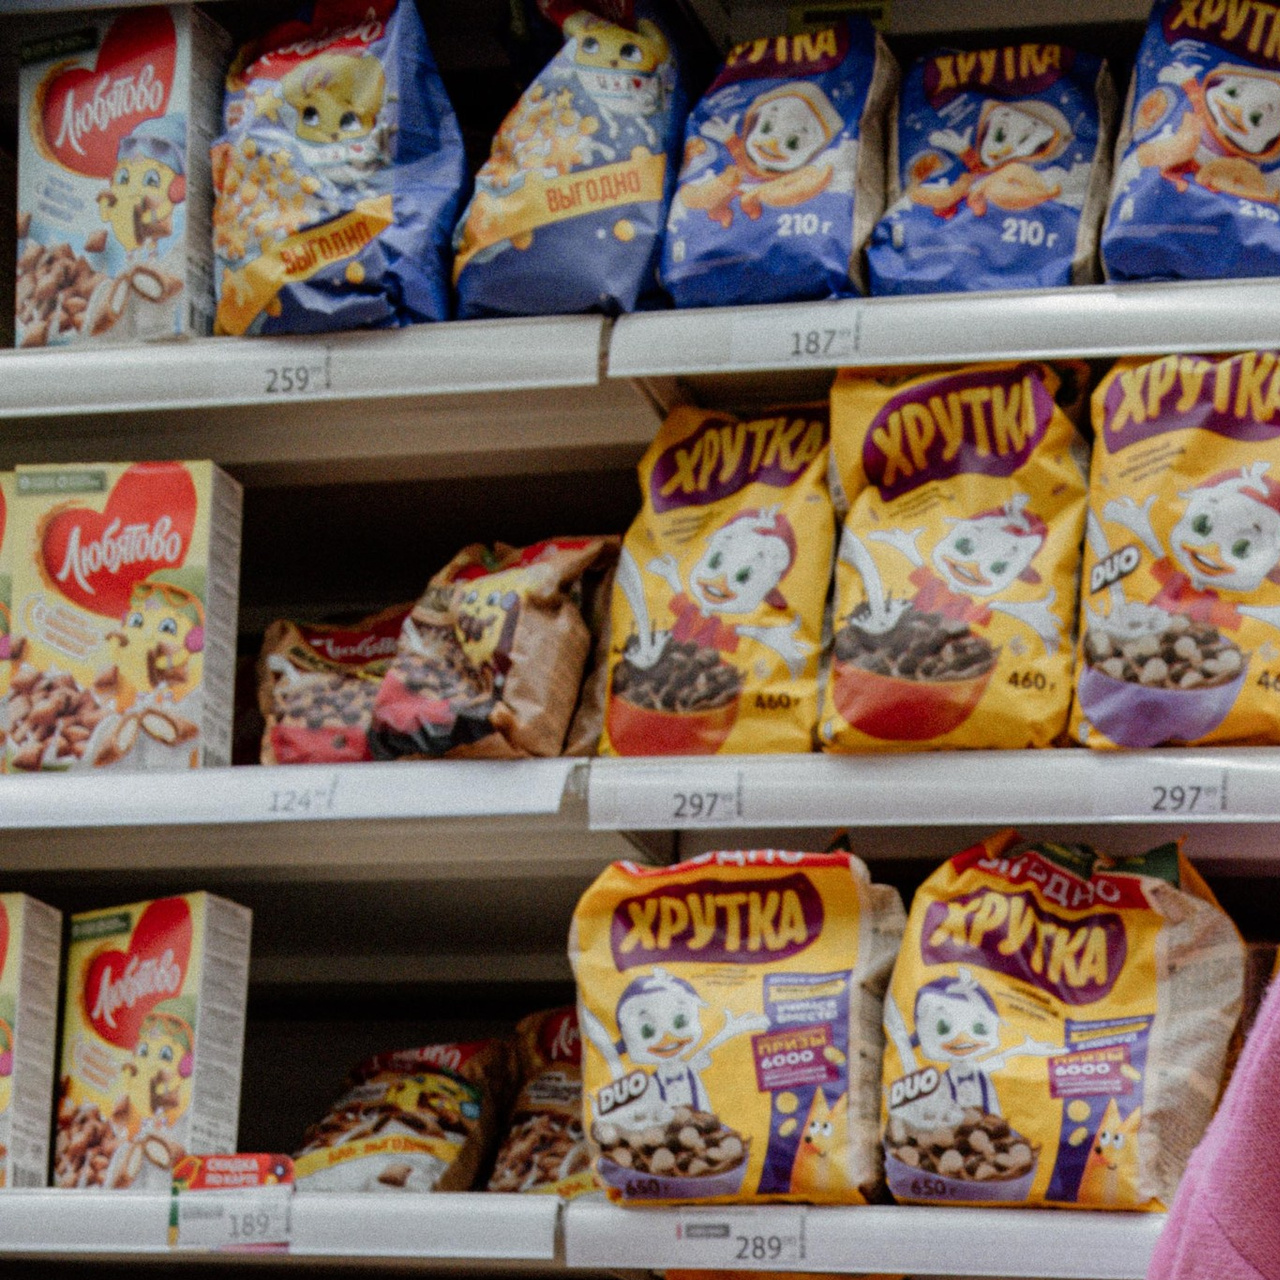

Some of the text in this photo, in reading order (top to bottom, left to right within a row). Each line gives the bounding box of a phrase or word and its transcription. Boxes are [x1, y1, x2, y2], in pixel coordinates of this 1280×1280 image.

[935, 43, 1062, 92] ХРУТКА
[56, 63, 165, 156] Любятово
[546, 170, 642, 214] ВЫГОДНО
[777, 212, 818, 238] 210
[1001, 217, 1044, 246] 210
[279, 219, 373, 276] ВЫГОДНО
[790, 329, 838, 356] 187
[264, 366, 311, 394] 259
[660, 416, 824, 498] ХРУТКА
[57, 516, 182, 595] Любятово
[1091, 546, 1139, 593] DUO
[1008, 670, 1048, 691] 460
[672, 793, 720, 819] 297
[1152, 785, 1202, 812] 297
[619, 889, 808, 954] ХРУТКА
[928, 890, 1108, 989] ХРУТКА
[599, 1071, 648, 1112] DUO
[228, 1212, 270, 1239] 189
[734, 1235, 783, 1260] 289
